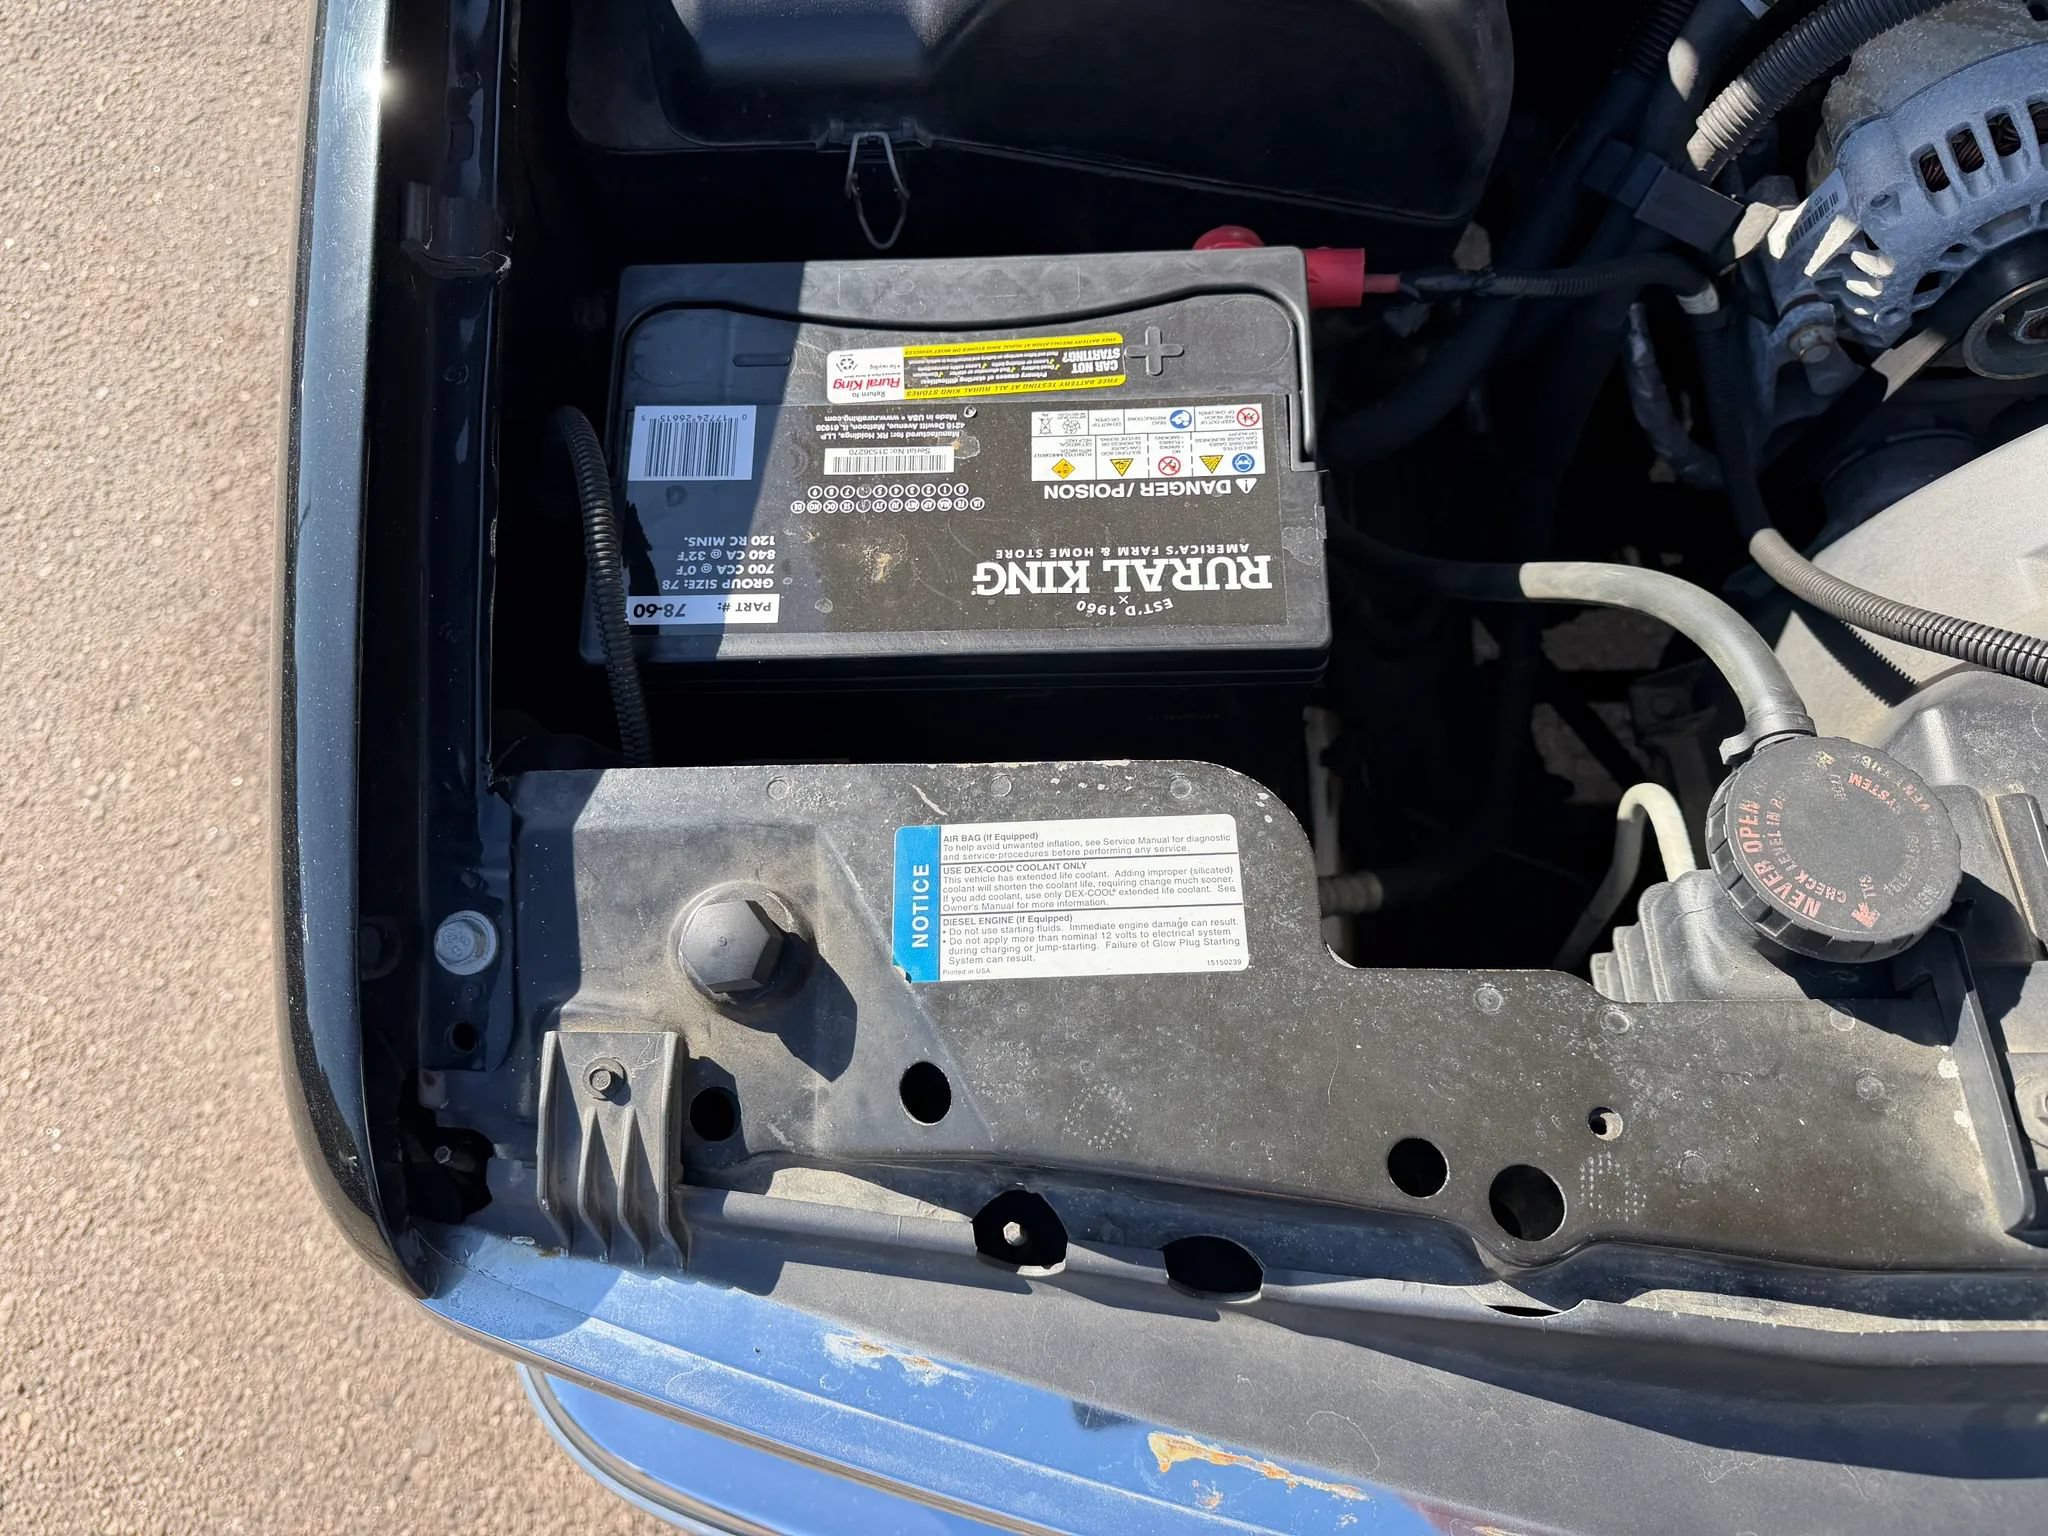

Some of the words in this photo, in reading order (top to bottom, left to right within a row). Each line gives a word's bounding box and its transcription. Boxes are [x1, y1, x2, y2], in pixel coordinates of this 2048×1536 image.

[1062, 347, 1121, 363] STARTING?
[1071, 361, 1094, 374] NOT
[1094, 359, 1118, 372] CAR
[833, 378, 863, 391] King
[865, 377, 901, 390] Rural
[1059, 379, 1095, 387] BATTERY
[906, 389, 939, 397] STORES
[659, 414, 692, 424] 26615
[697, 414, 727, 424] 17724
[907, 414, 925, 422] USA
[935, 413, 957, 421] Made
[820, 432, 837, 440] LLP
[905, 431, 960, 440] Manufactured
[1044, 482, 1135, 499] /POISON
[1140, 479, 1231, 497] DANGER
[684, 536, 725, 547] MINS.
[729, 536, 747, 546] RC
[751, 535, 776, 546] 120
[710, 549, 722, 559] @
[749, 550, 776, 560] 840
[996, 548, 1043, 559] STORE
[1049, 547, 1094, 558] HOME
[1100, 546, 1111, 557] &
[1117, 546, 1159, 556] FARM
[1165, 543, 1250, 556] AMERICA'S
[726, 550, 746, 562] CA
[701, 563, 712, 573] @
[718, 564, 745, 576] CCA
[748, 563, 775, 575] 700
[1103, 555, 1273, 593] RURAL
[662, 580, 679, 590] 78
[684, 579, 718, 589] SIZE:
[722, 577, 774, 589] GROUP
[633, 603, 686, 619] 78-60
[717, 602, 731, 612] #:
[735, 602, 771, 612] PART
[1075, 599, 1117, 616] 1960
[1738, 799, 1762, 853] OPEN
[943, 835, 959, 843] AIR
[961, 834, 981, 842] BAG
[983, 833, 992, 843] (If
[994, 832, 1039, 842] Equipped)
[943, 844, 954, 852] To
[955, 844, 975, 852] help
[976, 842, 1000, 851] avoid
[1002, 841, 1044, 850] unwanted
[1046, 839, 1083, 848] inflation,
[1085, 839, 1101, 847] see
[1103, 837, 1136, 846] Service
[1138, 836, 1170, 844] Manual
[1172, 835, 1184, 843] for
[1186, 834, 1231, 844] diagnostic
[943, 852, 960, 861] and
[998, 850, 1049, 860] procedures
[1051, 848, 1081, 857] before
[1083, 846, 1132, 856] performing
[1154, 844, 1190, 853] service.
[943, 866, 962, 875] USE
[1015, 862, 1061, 872] COOLANT
[1062, 861, 1087, 870] ONLY
[943, 876, 962, 884] This
[964, 874, 995, 883] vehicle
[997, 874, 1014, 882] has
[1016, 872, 1057, 881] extended
[1059, 871, 1073, 879] life
[1075, 870, 1110, 879] coolant.
[1114, 869, 1146, 878] Adding
[1147, 868, 1187, 878] improper
[1189, 866, 1233, 876] (silicated)
[942, 885, 975, 894] coolant
[977, 884, 992, 892] will
[993, 883, 1027, 892] shorten
[1029, 882, 1044, 890] the
[1045, 880, 1078, 889] coolant
[1079, 880, 1096, 888] life,
[1098, 878, 1137, 888] requiring
[1139, 878, 1172, 887] change
[1174, 876, 1199, 885] much
[1201, 876, 1234, 884] sooner.
[1754, 858, 1821, 918] NEVER
[1794, 870, 1846, 903] CHECK
[943, 894, 949, 903] If
[951, 895, 967, 904] you
[969, 893, 986, 902] add
[988, 892, 1023, 901] coolant,
[1025, 892, 1042, 900] use
[1044, 890, 1062, 900] only
[1118, 887, 1159, 896] extended
[1161, 886, 1175, 894] life
[1177, 885, 1212, 894] coolant.
[1217, 884, 1237, 893] See
[912, 863, 930, 948] NOTICE
[942, 903, 979, 912] Owner's
[981, 901, 1014, 911] Manual
[1016, 901, 1029, 909] for
[1057, 898, 1109, 908] information.
[943, 917, 977, 927] DIESEL
[978, 915, 1014, 925] ENGINE
[1016, 915, 1025, 925] (If
[1027, 914, 1073, 924] Equipped)
[949, 928, 962, 936] Do
[964, 927, 979, 936] not
[981, 927, 998, 935] use
[1000, 925, 1034, 934] starting
[1036, 922, 1064, 932] fluids.
[1069, 922, 1116, 931] Immediate
[1118, 921, 1149, 931] engine
[1151, 920, 1189, 929] damage
[1210, 917, 1238, 926] result.
[975, 967, 991, 975] USA
